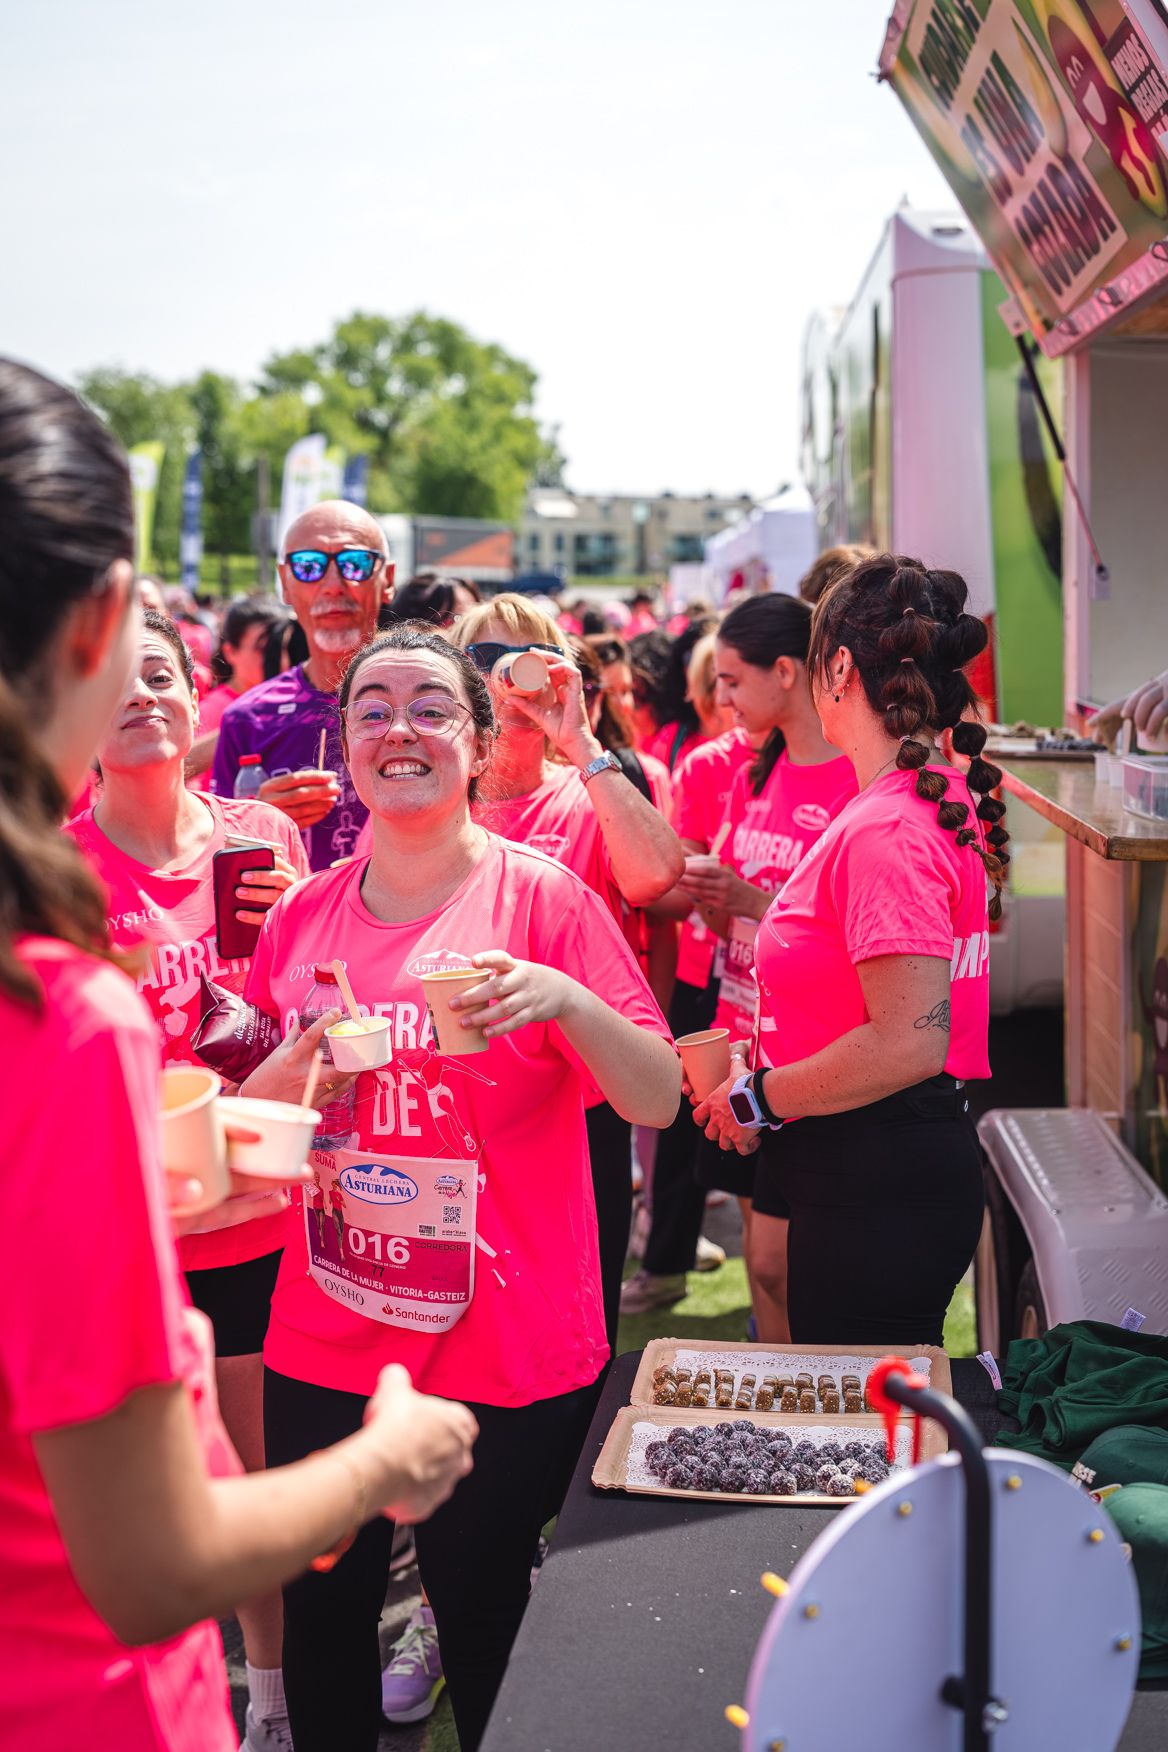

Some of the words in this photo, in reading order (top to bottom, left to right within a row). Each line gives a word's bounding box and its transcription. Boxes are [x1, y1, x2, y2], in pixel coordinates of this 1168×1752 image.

[1111, 32, 1150, 91] MENOS
[973, 49, 1045, 177] UNA
[371, 1069, 422, 1137] DE
[315, 1152, 337, 1172] SUMA
[345, 1174, 412, 1198] ASTURIANA
[348, 1228, 410, 1265] 016
[415, 1241, 468, 1252] CORREDORA
[313, 1255, 341, 1275] CARRERA
[341, 1267, 350, 1279] DE
[350, 1272, 359, 1283] LA
[359, 1277, 384, 1291] MUJER
[390, 1285, 466, 1301] VITORIA-GASTEIZ
[324, 1278, 365, 1306] OYSHO
[395, 1307, 450, 1324] Santander
